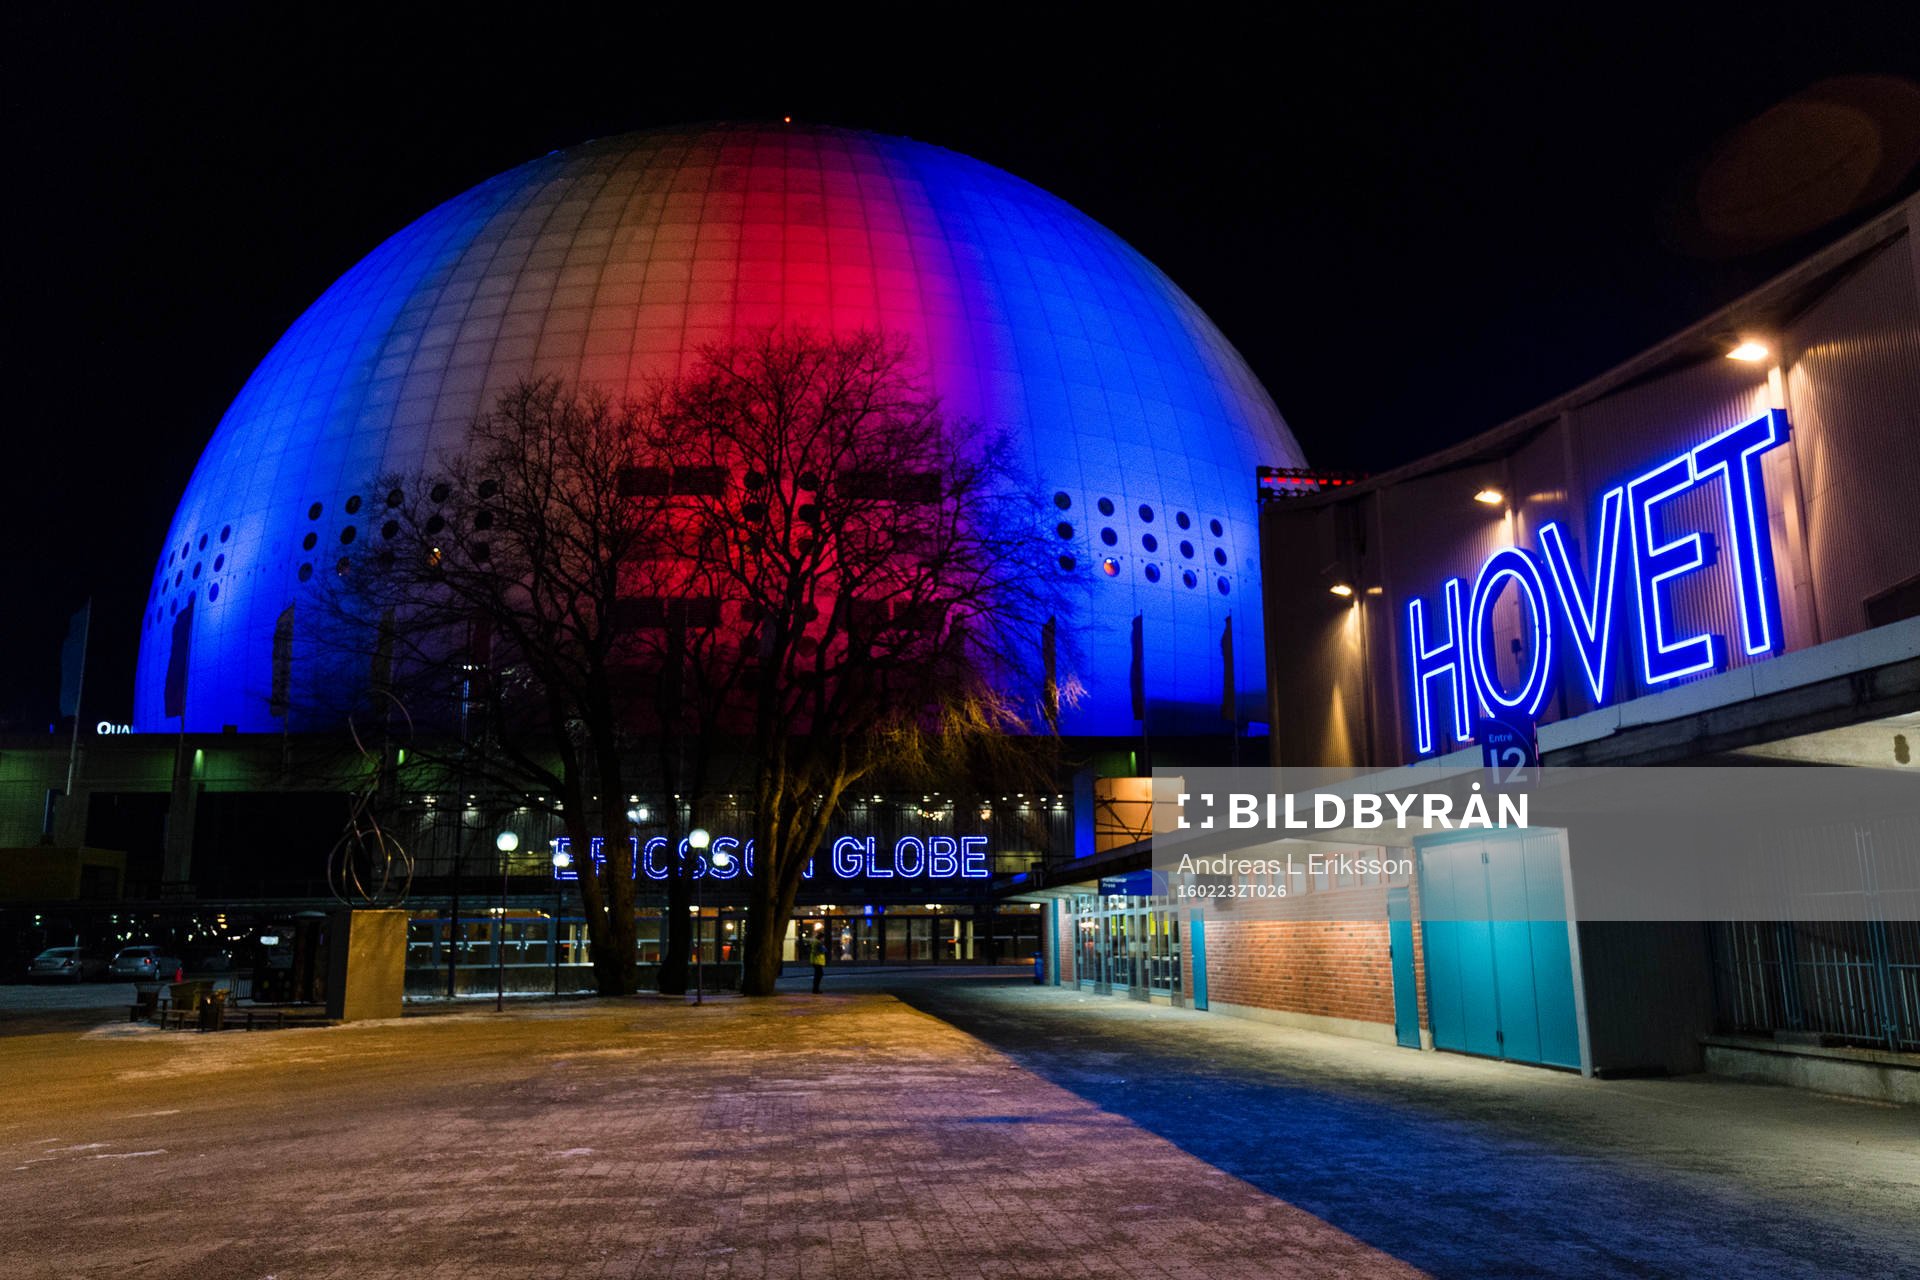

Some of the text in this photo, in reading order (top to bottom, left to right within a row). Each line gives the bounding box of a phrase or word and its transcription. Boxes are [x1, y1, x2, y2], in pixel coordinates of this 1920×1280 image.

[1409, 407, 1789, 754] HOVET
[1488, 732, 1513, 743] Entré
[1490, 747, 1528, 785] 12
[833, 836, 989, 878] GLOBE
